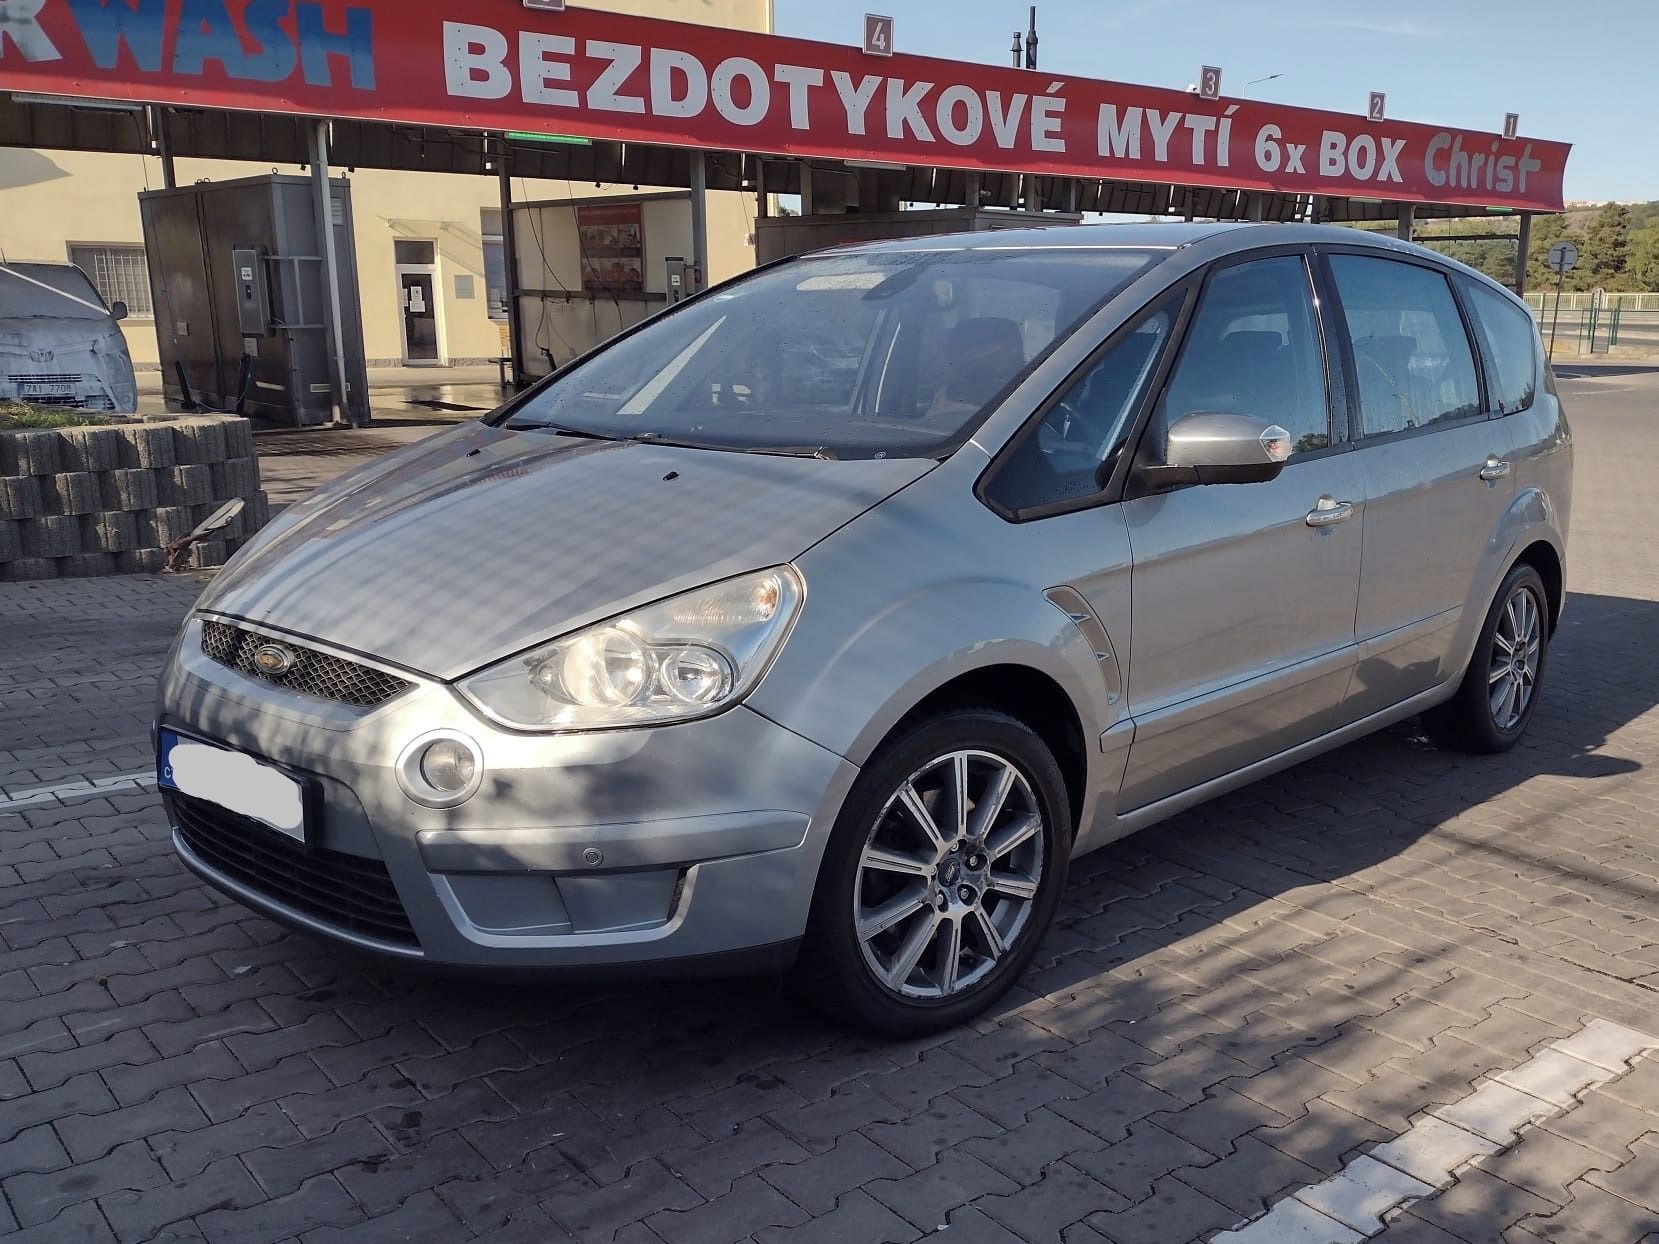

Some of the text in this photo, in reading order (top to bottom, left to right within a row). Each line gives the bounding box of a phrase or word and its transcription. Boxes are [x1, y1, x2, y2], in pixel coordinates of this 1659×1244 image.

[66, 0, 376, 91] WASH
[871, 21, 886, 50] 4
[1205, 71, 1216, 95] 3
[442, 20, 1408, 183] BEZDOTYKOVÉ MYTÍ 6x BOX
[1372, 97, 1382, 118] 2
[1508, 117, 1515, 136] 1
[1424, 132, 1542, 194] Christ
